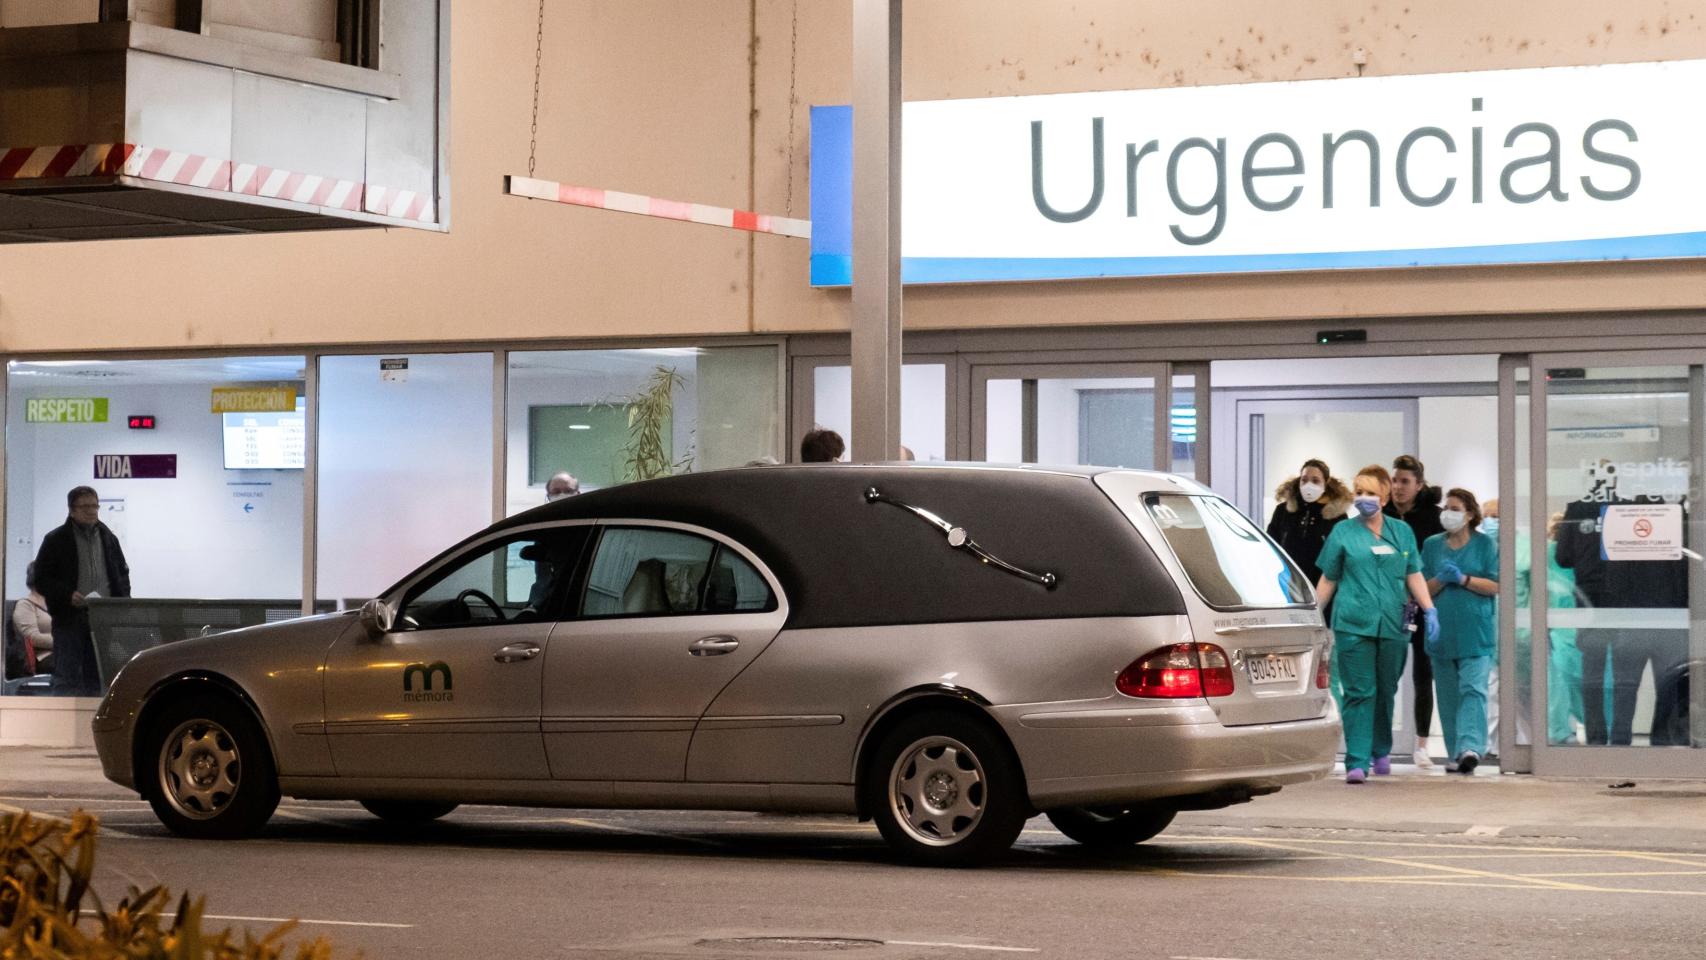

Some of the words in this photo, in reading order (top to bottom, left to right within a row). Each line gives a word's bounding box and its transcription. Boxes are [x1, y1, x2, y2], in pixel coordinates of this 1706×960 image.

[1030, 97, 1642, 246] Urgencias
[27, 399, 94, 421] RESPETO
[212, 388, 287, 411] PROTECCIÓN
[96, 455, 132, 478] VIDA
[1581, 457, 1701, 480] Hospita
[1250, 661, 1277, 680] 9045
[1278, 660, 1295, 678] FKL
